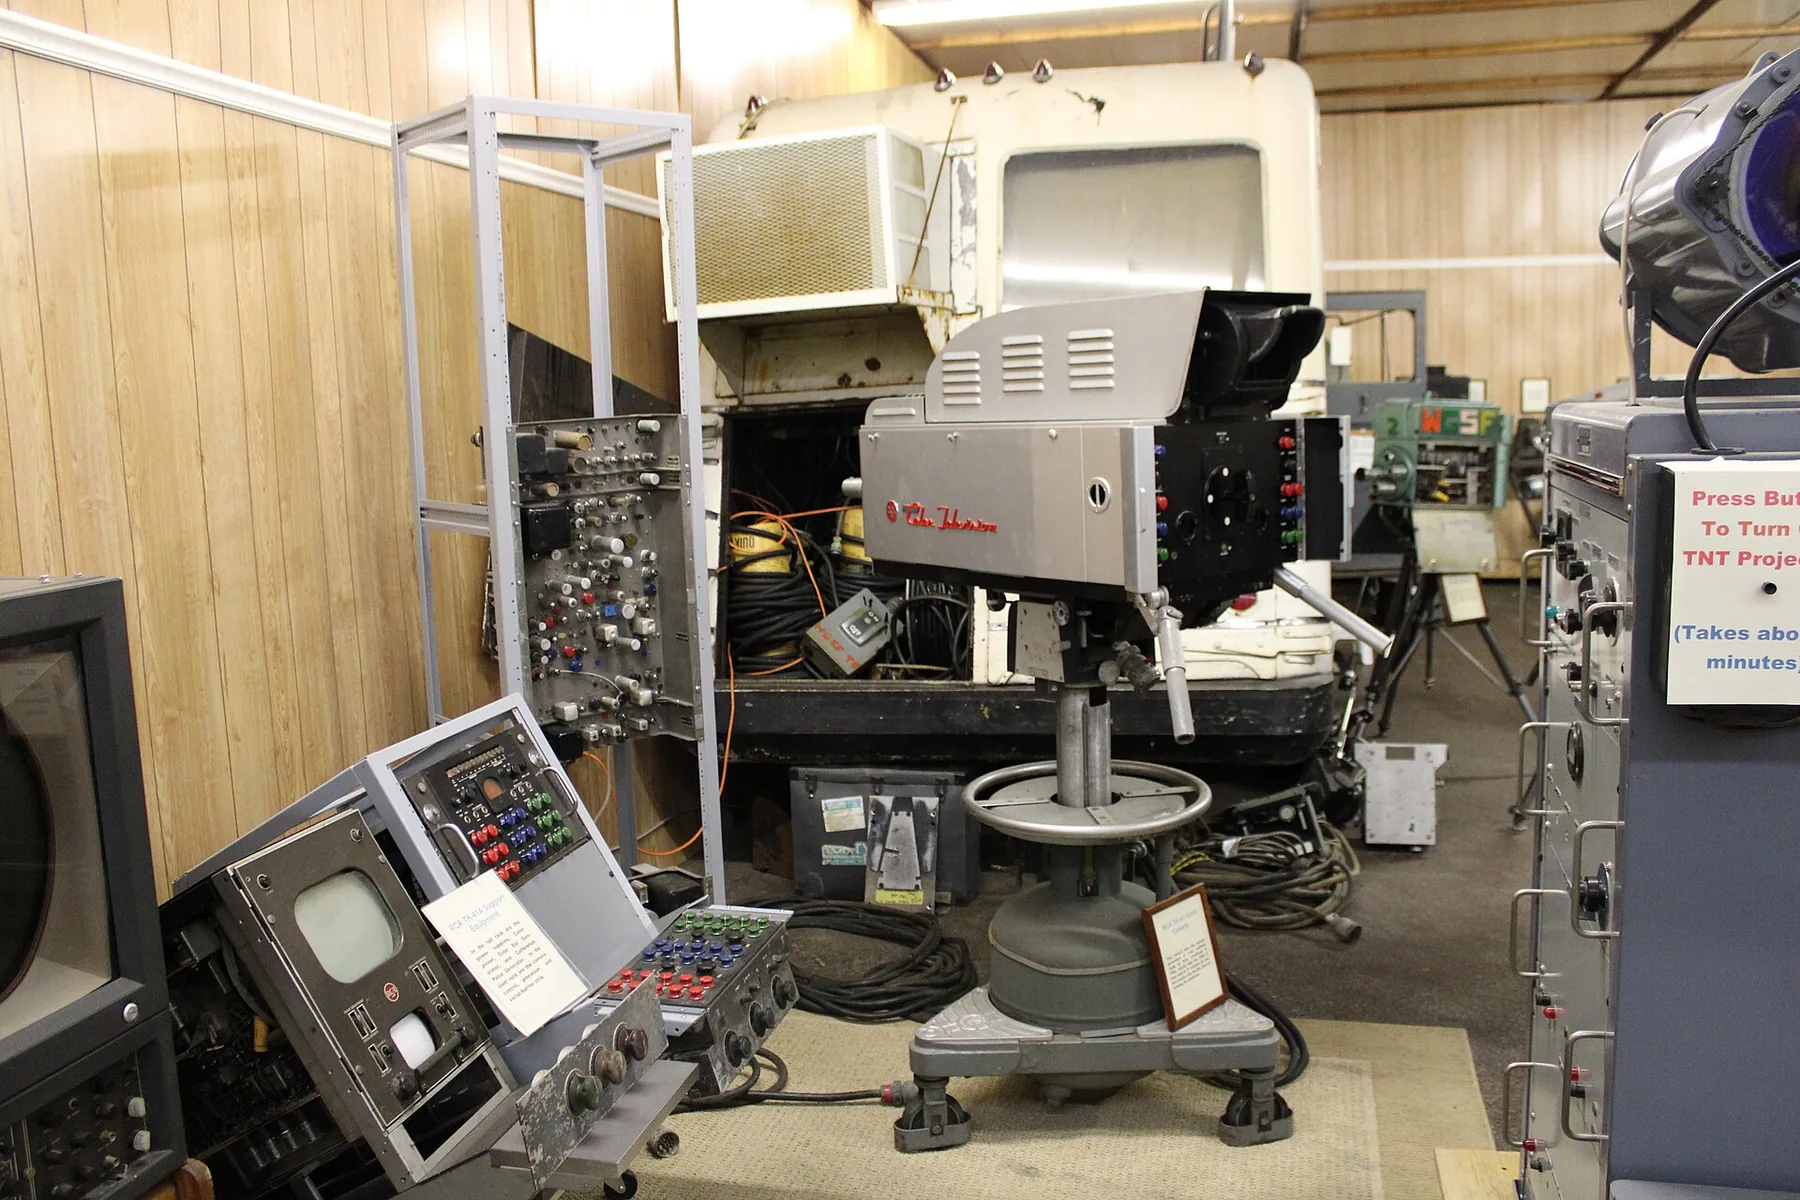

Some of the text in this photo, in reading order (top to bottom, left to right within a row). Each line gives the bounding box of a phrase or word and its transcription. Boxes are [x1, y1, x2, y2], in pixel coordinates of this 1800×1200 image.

[1387, 417, 1398, 435] 2
[1692, 491, 1755, 506] Press
[1702, 521, 1730, 536] To
[1738, 521, 1790, 536] Turn
[1683, 551, 1800, 570] TNT Proje
[848, 623, 863, 637] OFF
[1674, 625, 1799, 643] (Takes abo
